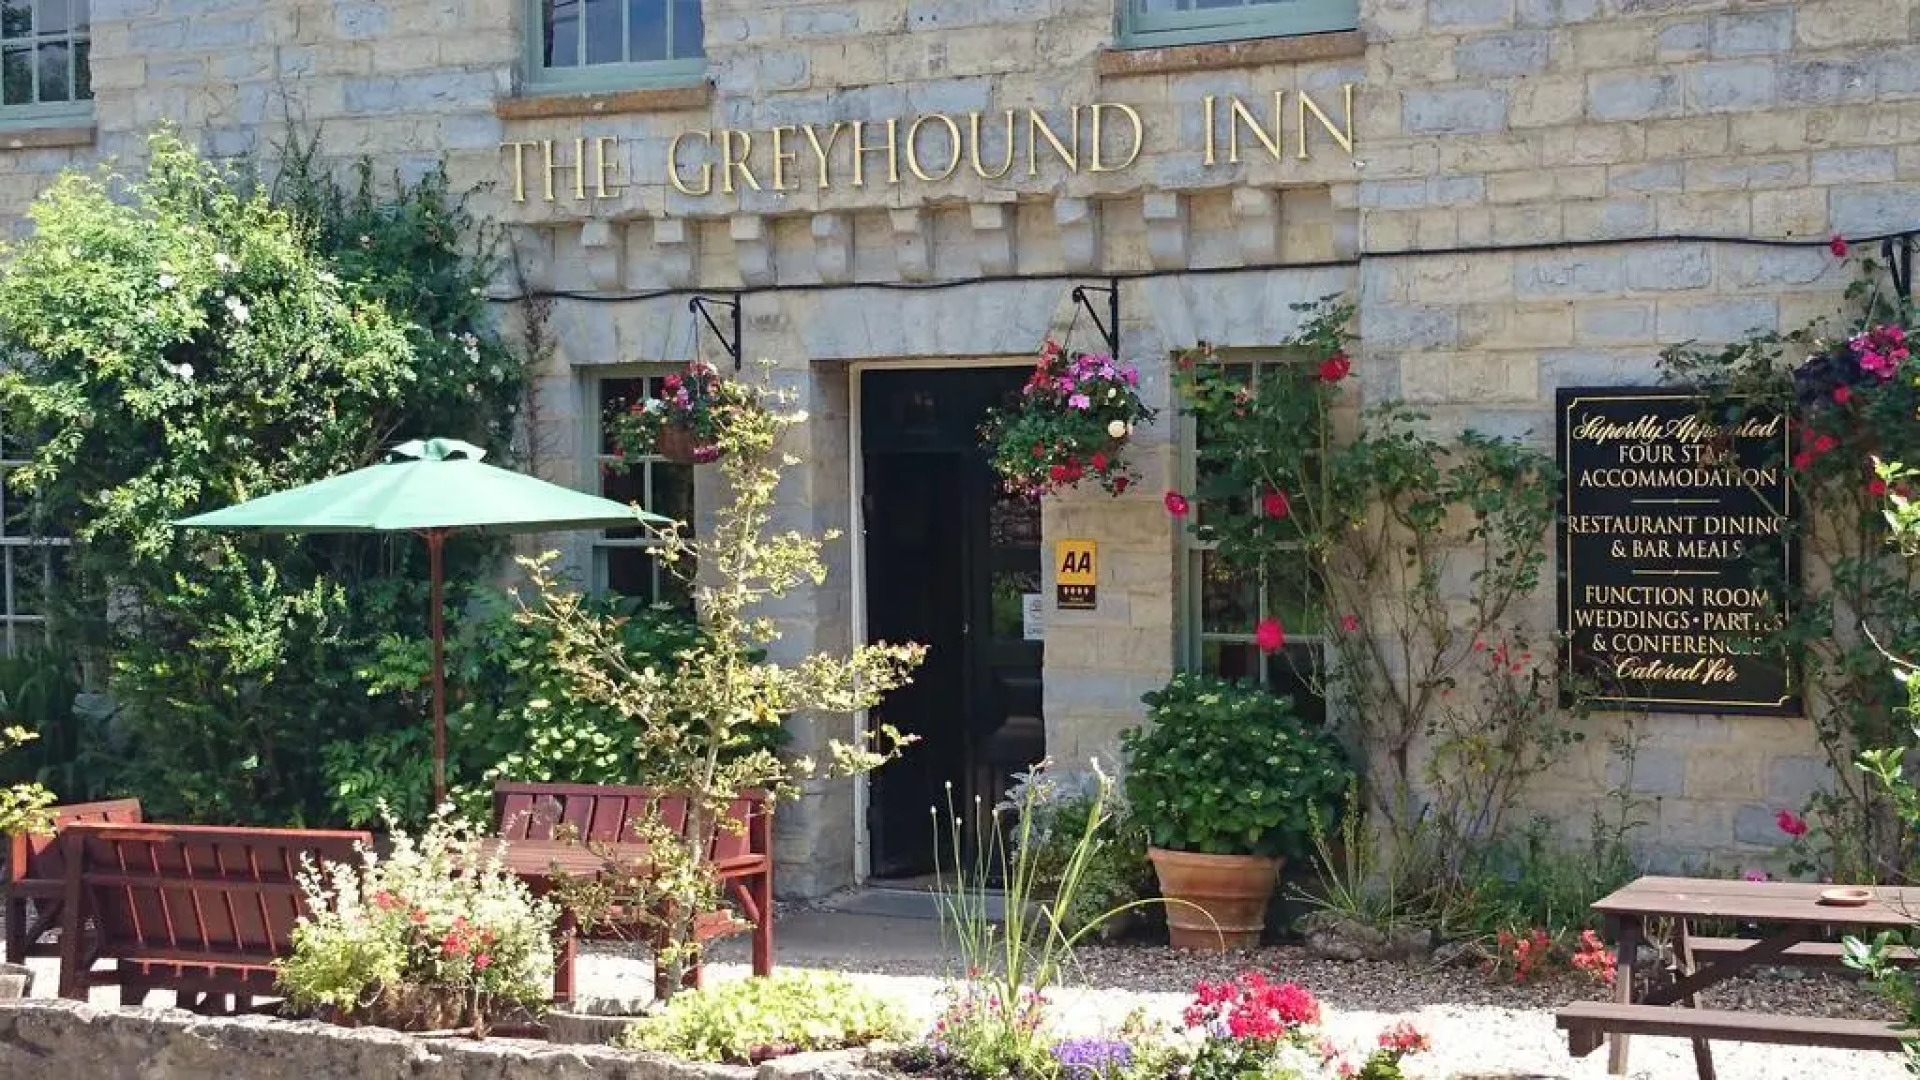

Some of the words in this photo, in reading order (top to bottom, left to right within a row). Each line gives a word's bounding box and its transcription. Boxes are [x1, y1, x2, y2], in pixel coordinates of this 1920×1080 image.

[500, 135, 620, 202] THE
[667, 102, 1145, 197] GREYHOUND
[1202, 83, 1355, 166] INN
[1573, 412, 1664, 445] Superbly
[1663, 414, 1783, 444] Appoted
[1619, 444, 1676, 465] FOUR
[1579, 468, 1778, 488] ACCOMMODATION
[1568, 515, 1698, 535] RESTAURANT
[1611, 540, 1627, 559] &
[1632, 540, 1672, 559] BAR
[1061, 550, 1092, 573] AA
[1585, 585, 1694, 606] FUNCTION
[1702, 586, 1770, 607] ROOM
[1575, 609, 1691, 629] WEDDINGS
[1592, 633, 1607, 653] &
[1613, 655, 1706, 682] Catered
[1701, 657, 1739, 686] for
